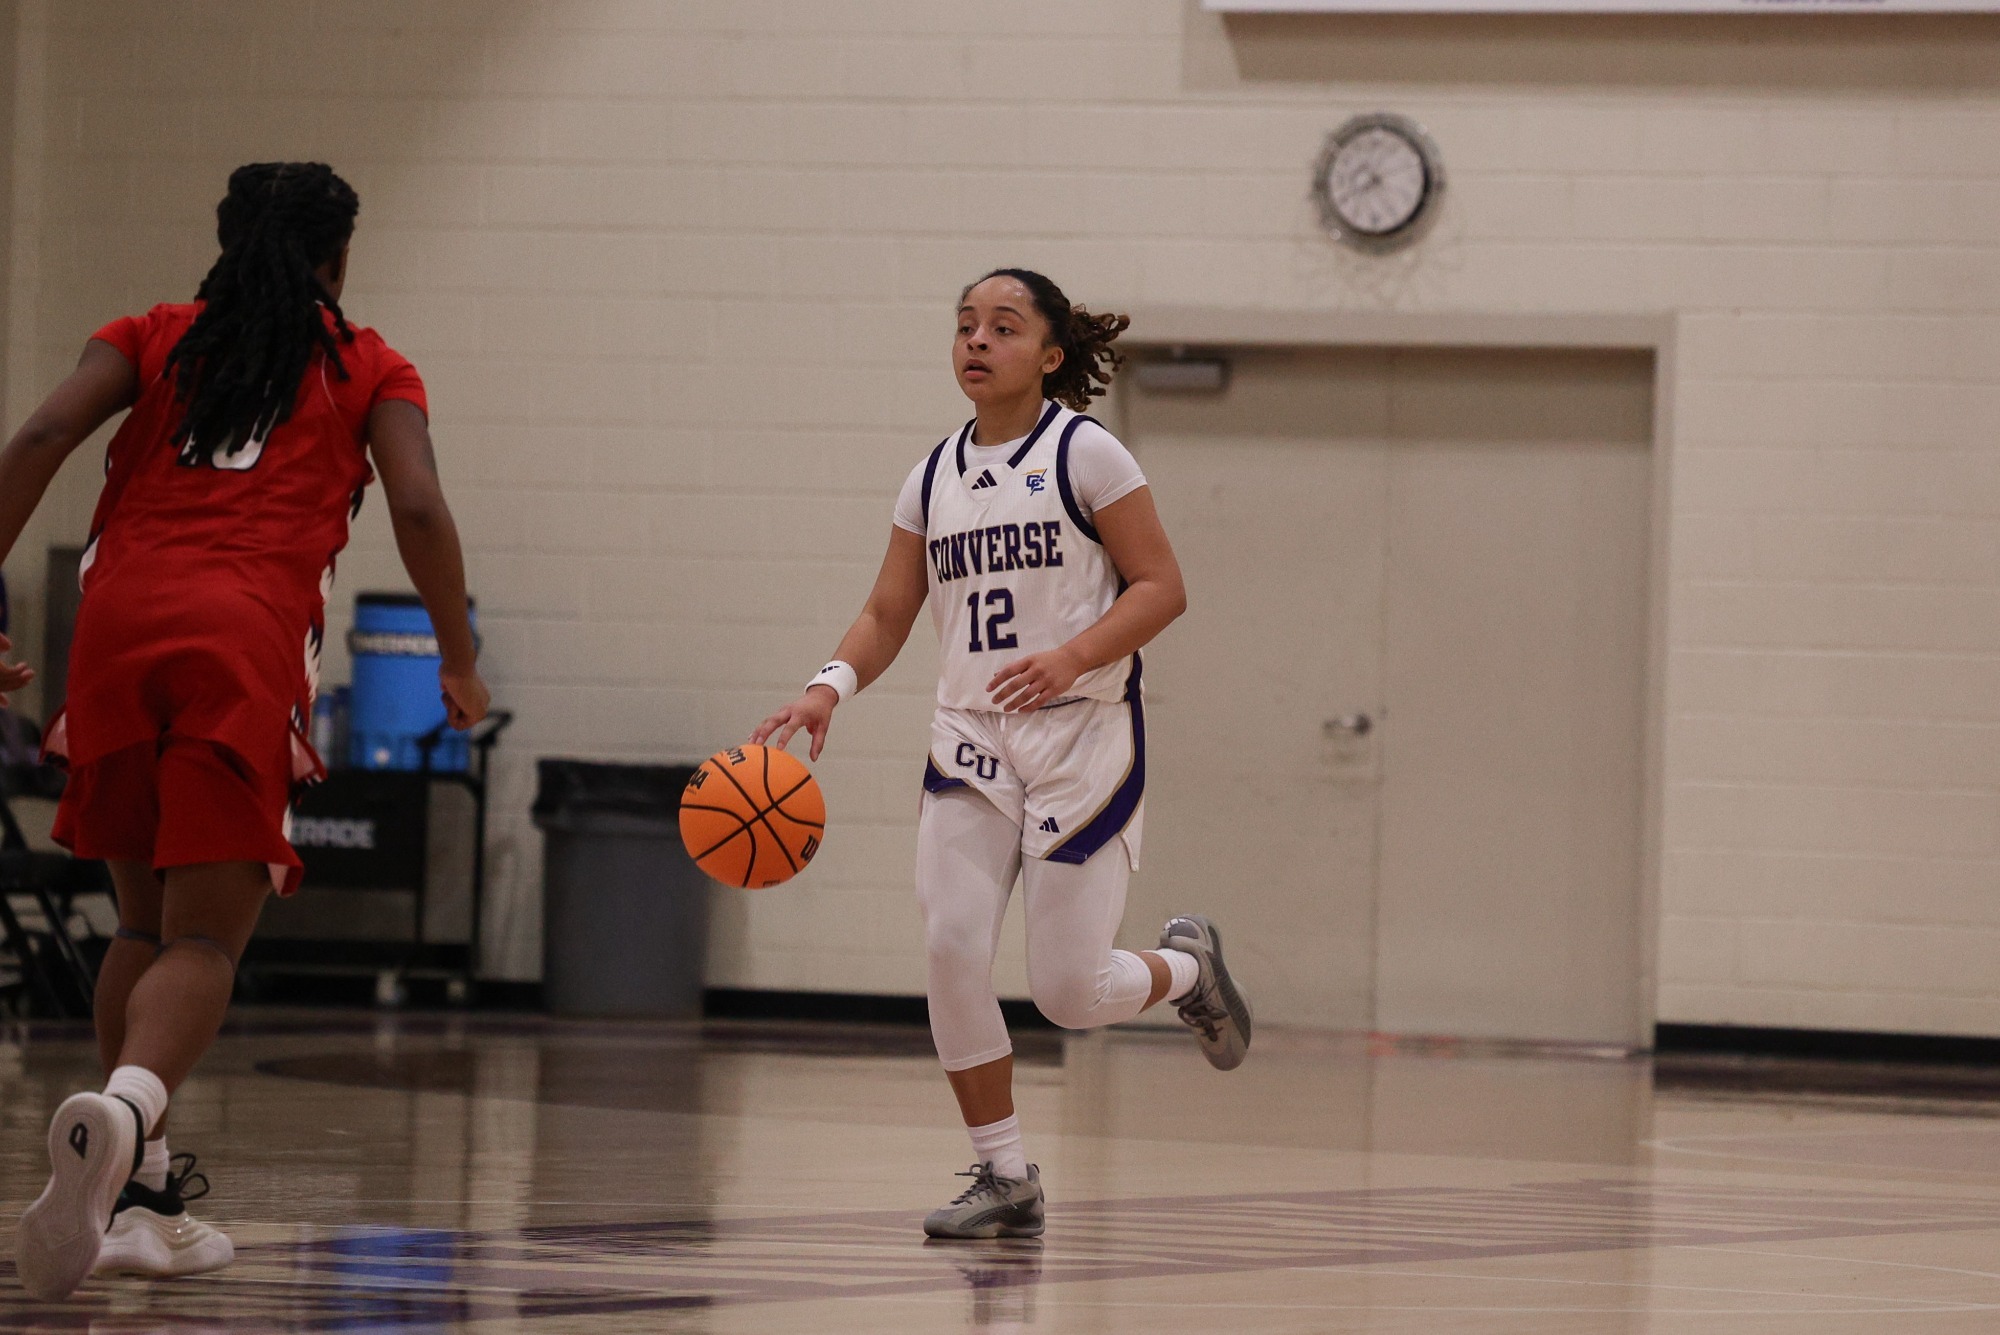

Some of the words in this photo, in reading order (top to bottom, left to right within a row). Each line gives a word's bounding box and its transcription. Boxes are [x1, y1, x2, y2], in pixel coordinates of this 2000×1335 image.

[929, 520, 1063, 584] CONVERSE
[967, 587, 1018, 653] 12
[955, 742, 999, 780] CU
[291, 816, 375, 849] ERADE
